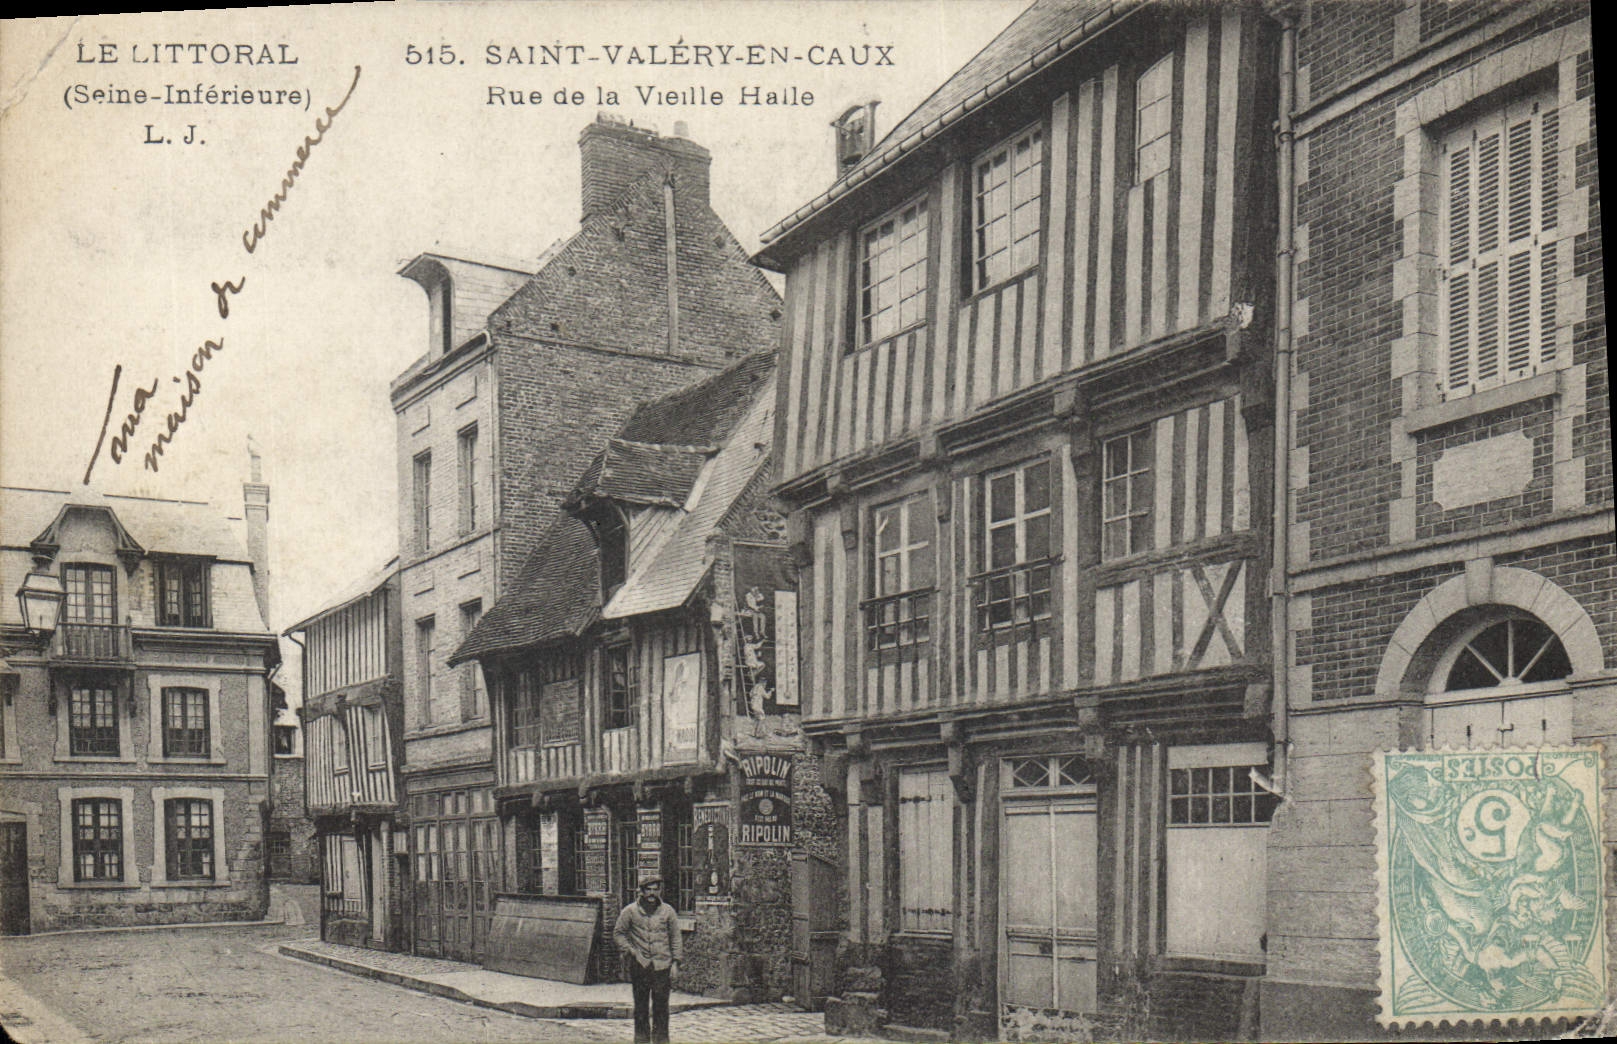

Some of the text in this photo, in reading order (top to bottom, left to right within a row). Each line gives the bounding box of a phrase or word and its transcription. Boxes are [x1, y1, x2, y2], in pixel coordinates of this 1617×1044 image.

[742, 756, 791, 778] RIPOLIN
[1447, 756, 1541, 778] POSTES
[742, 825, 790, 842] RIPOLIN
[1474, 796, 1511, 857] 5
